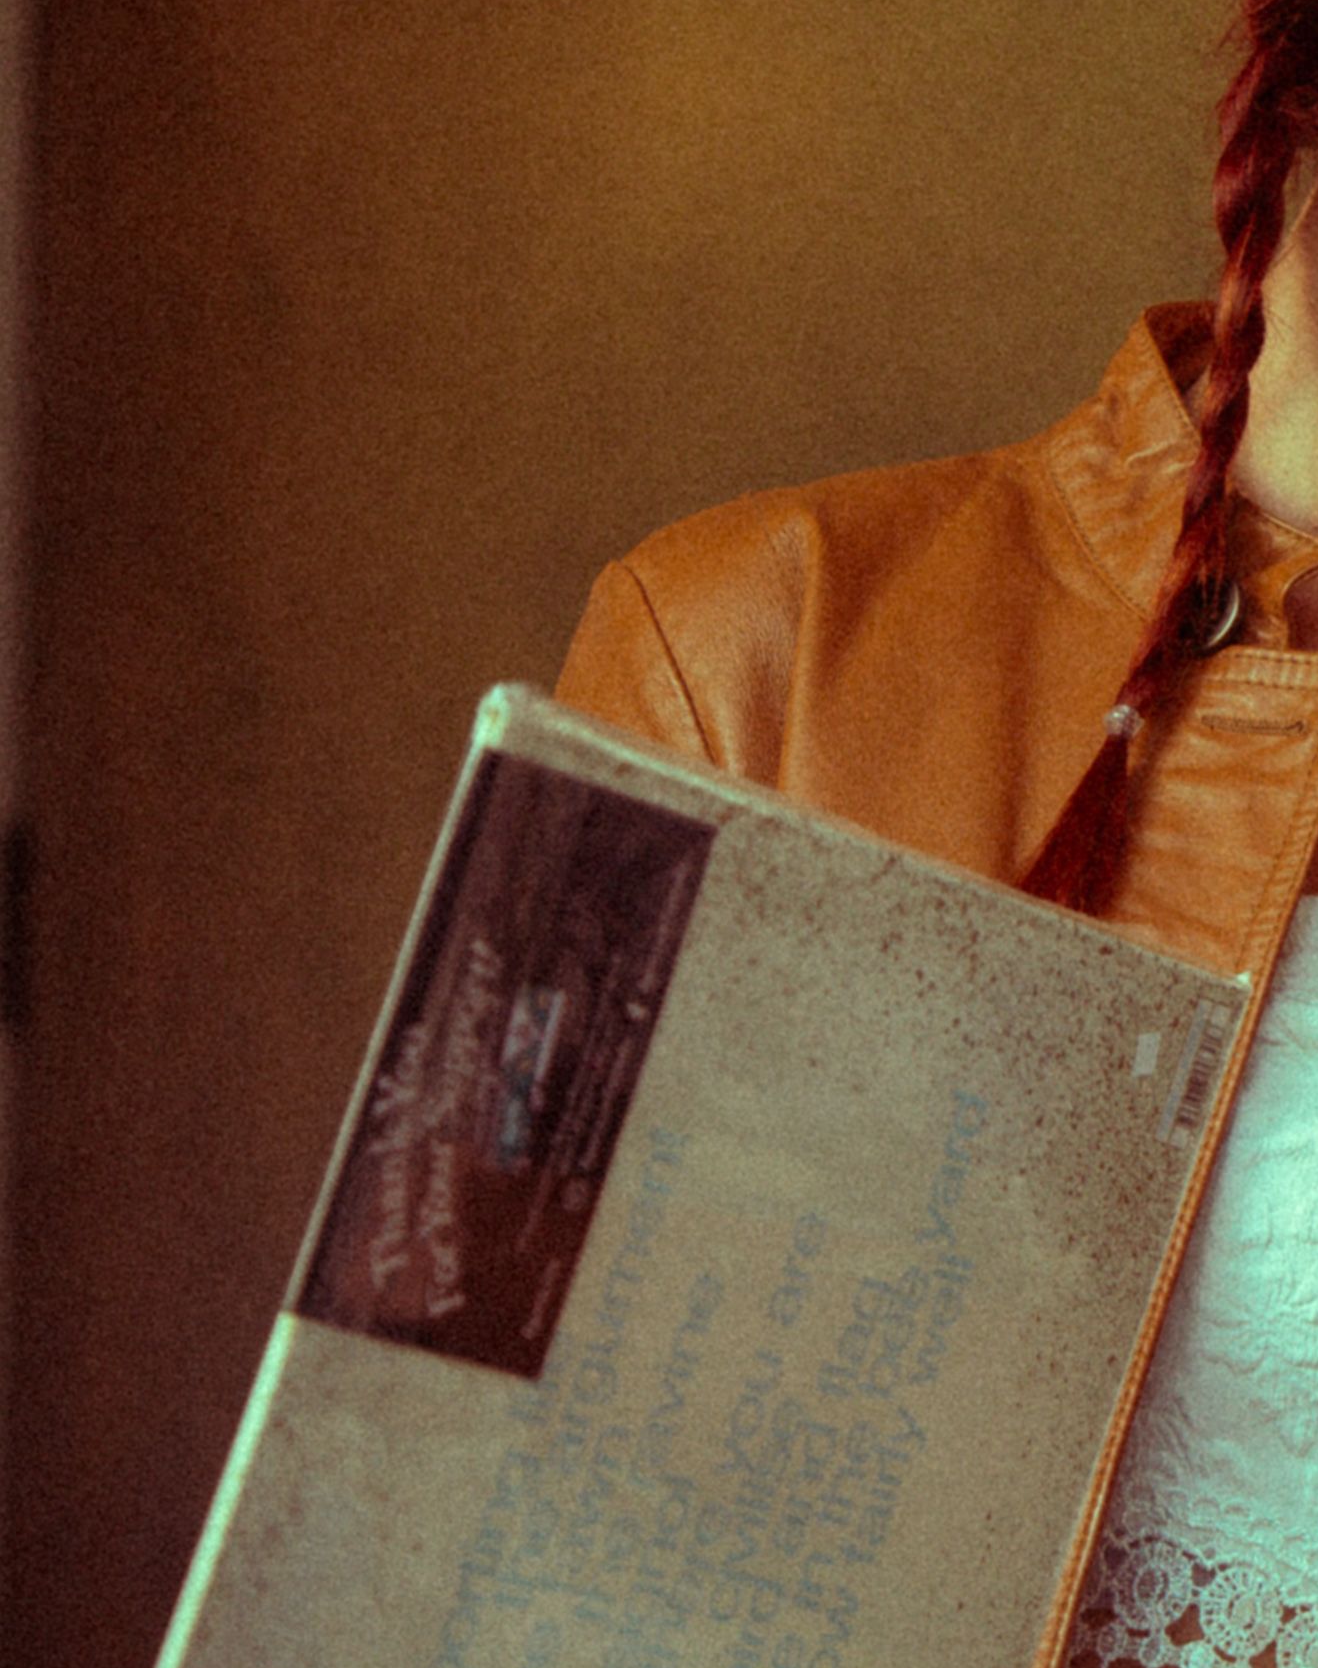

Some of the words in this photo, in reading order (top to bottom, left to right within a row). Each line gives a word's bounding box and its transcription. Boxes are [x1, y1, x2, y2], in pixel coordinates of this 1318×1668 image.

[543, 1126, 690, 1477] argument
[628, 1270, 722, 1486] ravine
[715, 1350, 781, 1480] you
[768, 1209, 826, 1325] are
[765, 1422, 833, 1555] and
[819, 1274, 889, 1402] flag
[792, 1550, 832, 1609] in
[818, 1416, 878, 1528] the
[913, 1092, 997, 1246] yard
[842, 1409, 926, 1568] fairly
[905, 1255, 973, 1388] well
